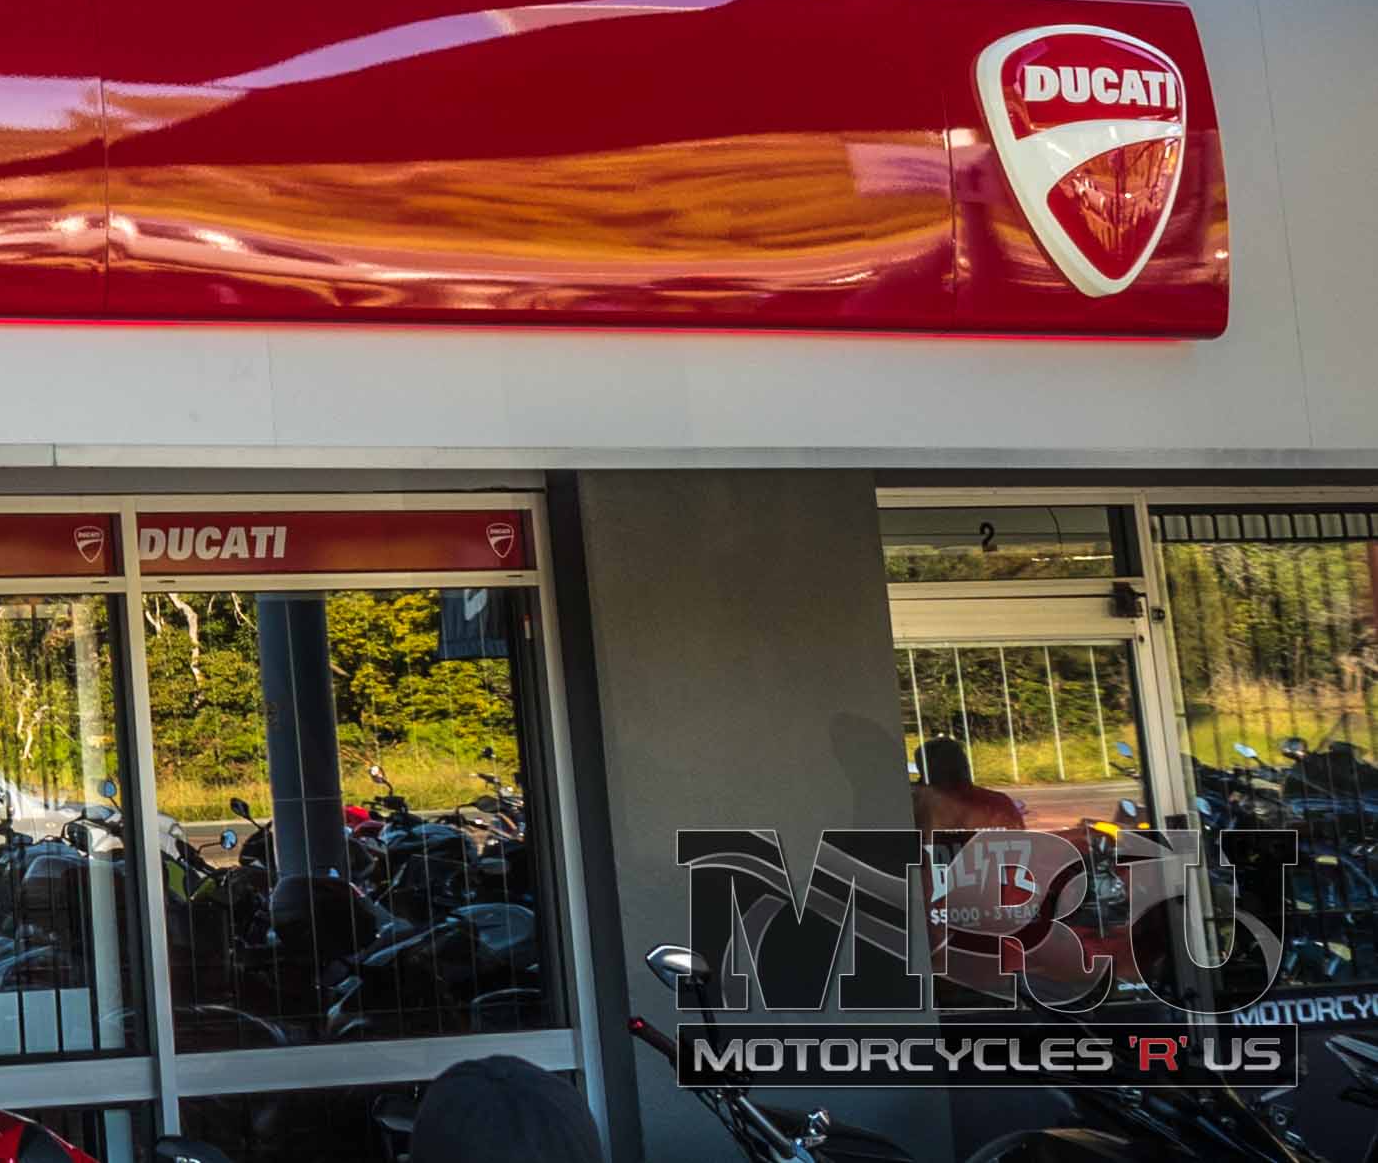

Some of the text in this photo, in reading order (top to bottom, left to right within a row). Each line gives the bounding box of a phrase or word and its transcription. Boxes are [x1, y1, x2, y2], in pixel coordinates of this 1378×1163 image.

[1025, 65, 1177, 109] DUCATI
[140, 526, 287, 561] DUCATI
[979, 521, 996, 552] 2
[924, 839, 1038, 902] BLITZ
